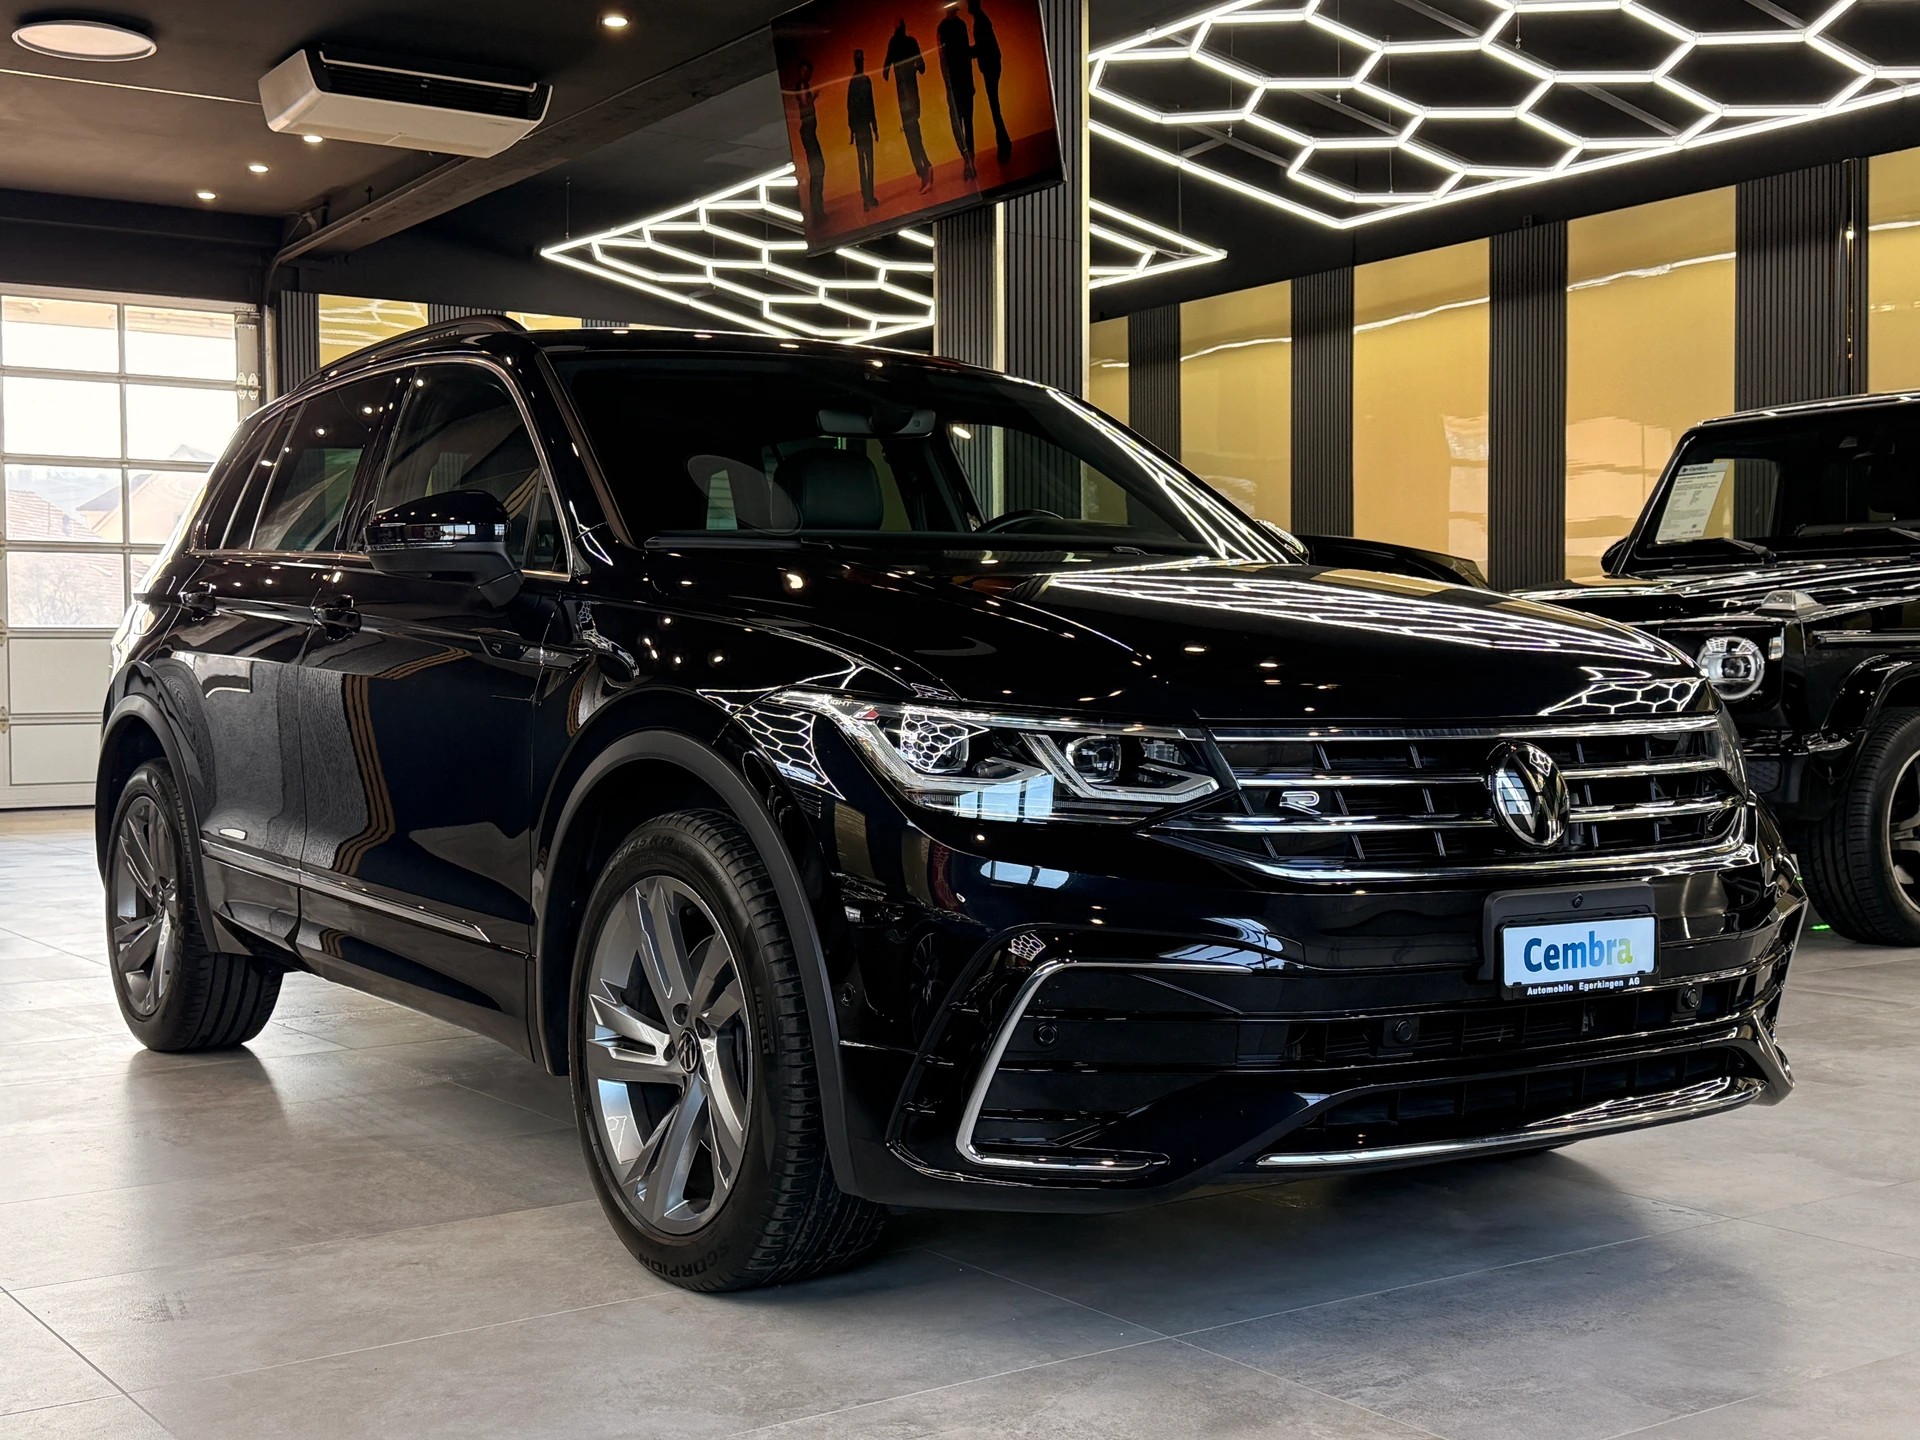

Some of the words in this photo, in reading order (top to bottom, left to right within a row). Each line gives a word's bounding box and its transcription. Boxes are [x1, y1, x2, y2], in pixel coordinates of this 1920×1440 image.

[1279, 791, 1321, 814] R
[1524, 930, 1633, 973] Cembra
[1527, 983, 1574, 996] Automobile
[1579, 980, 1624, 991] Egerkingen
[1628, 977, 1640, 986] AG
[638, 1240, 730, 1278] SCORPION
